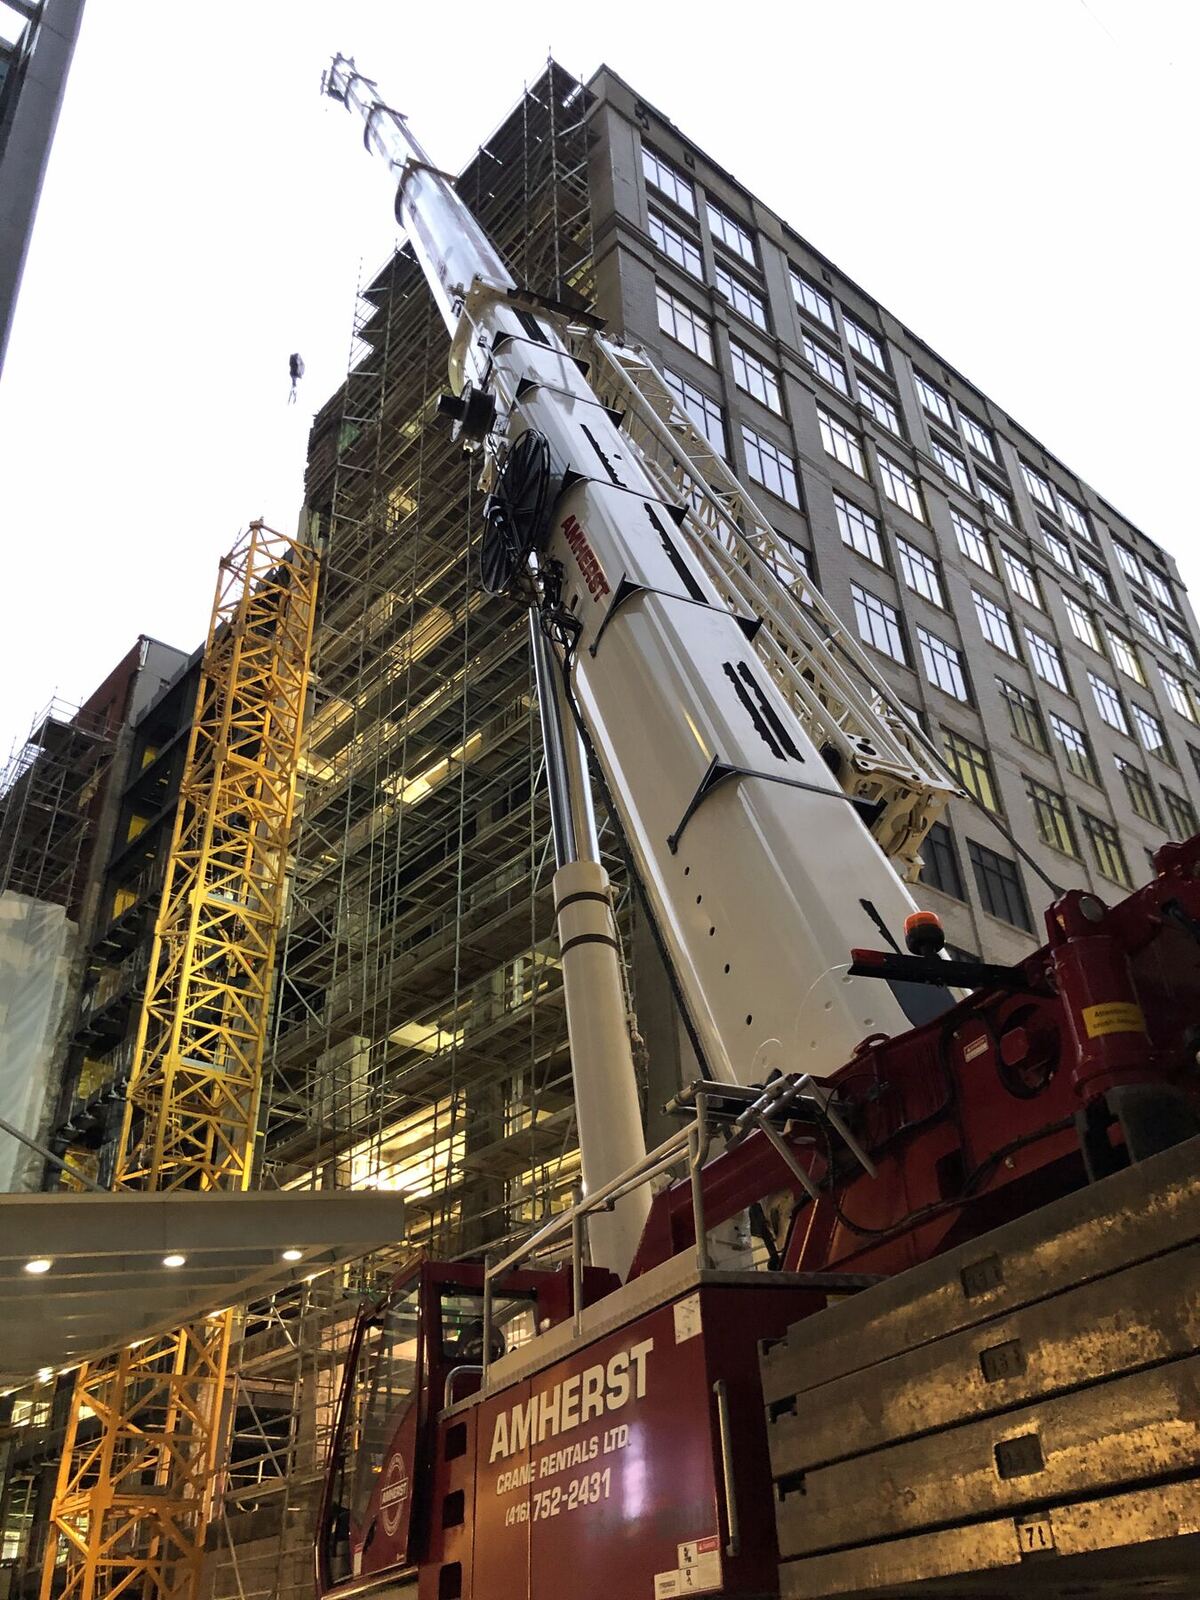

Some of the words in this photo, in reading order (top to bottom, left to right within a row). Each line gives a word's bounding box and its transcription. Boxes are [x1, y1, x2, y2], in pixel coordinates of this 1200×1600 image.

[560, 515, 610, 603] AMHERST
[489, 1337, 654, 1464] AMHERST
[496, 1461, 536, 1495] CRANE
[539, 1435, 599, 1479] RENTALS
[532, 1467, 611, 1522] 752-2431
